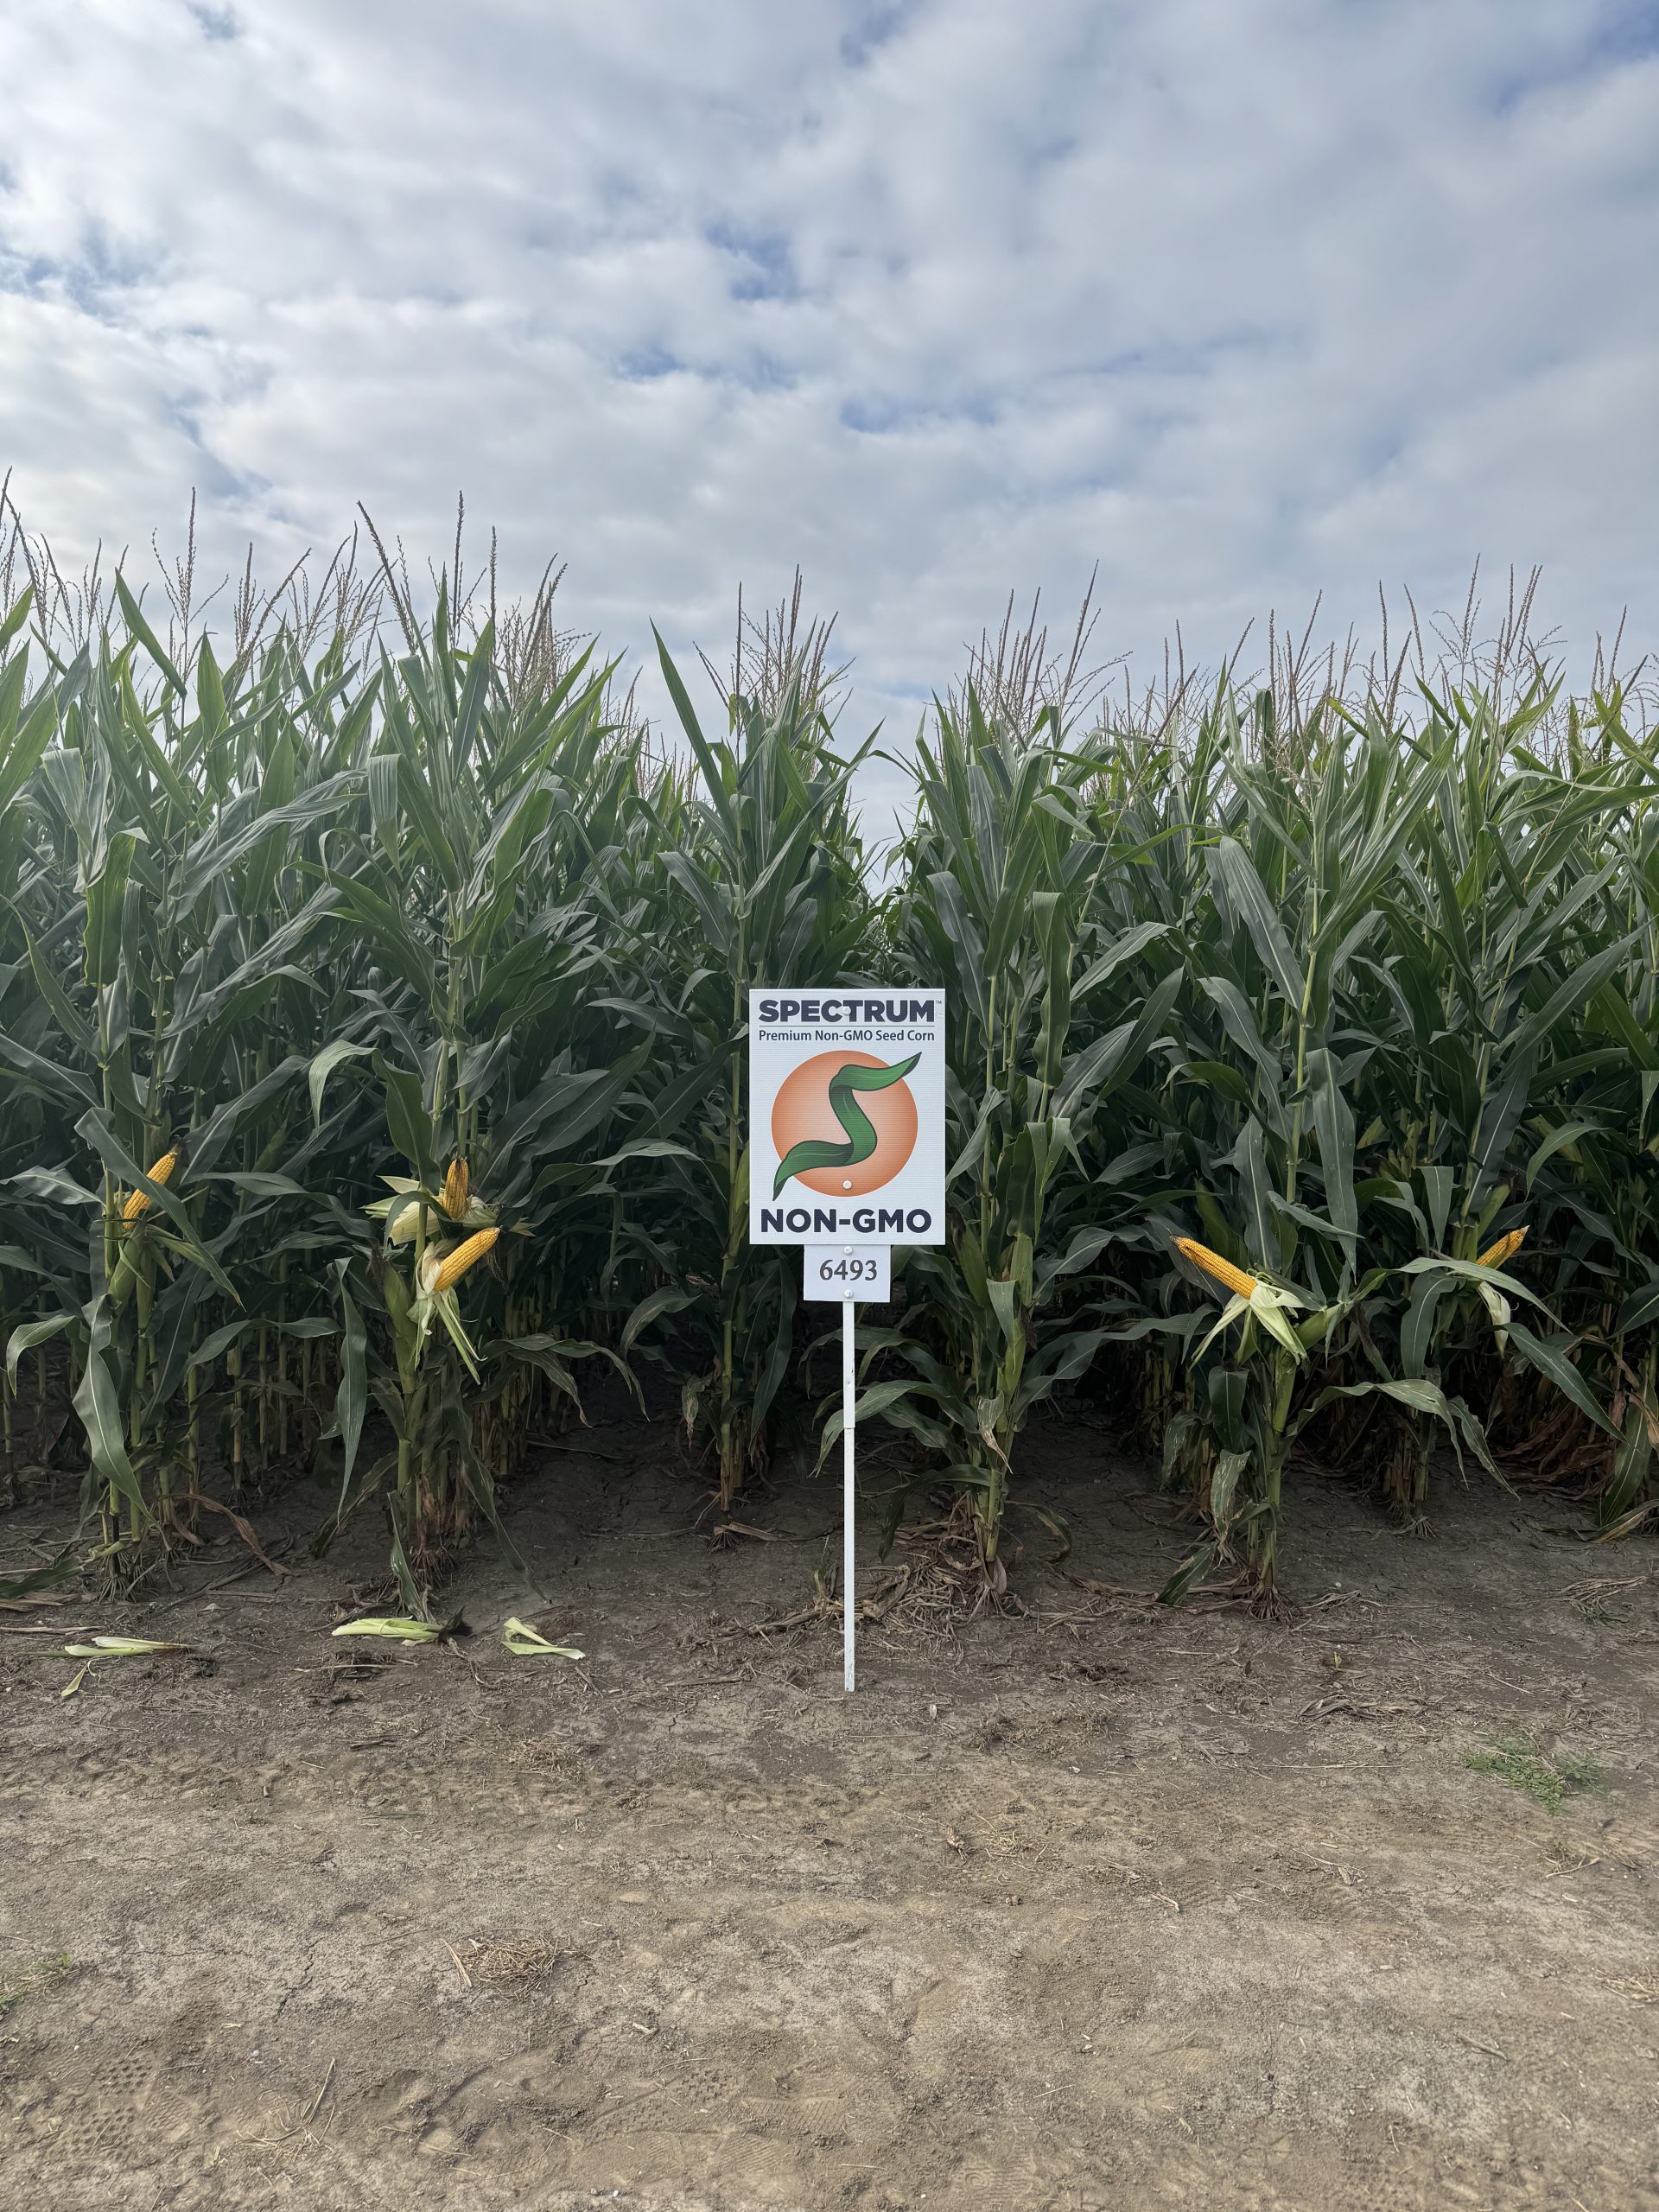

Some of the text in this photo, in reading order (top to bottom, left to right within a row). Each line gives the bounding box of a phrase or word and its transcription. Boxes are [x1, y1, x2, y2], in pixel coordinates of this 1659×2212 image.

[758, 999, 935, 1023] SPECTRUM
[759, 1030, 935, 1041] Premium Non-GMO Seed Corn
[760, 1208, 932, 1234] NON-GMO
[819, 1259, 878, 1281] 6493
